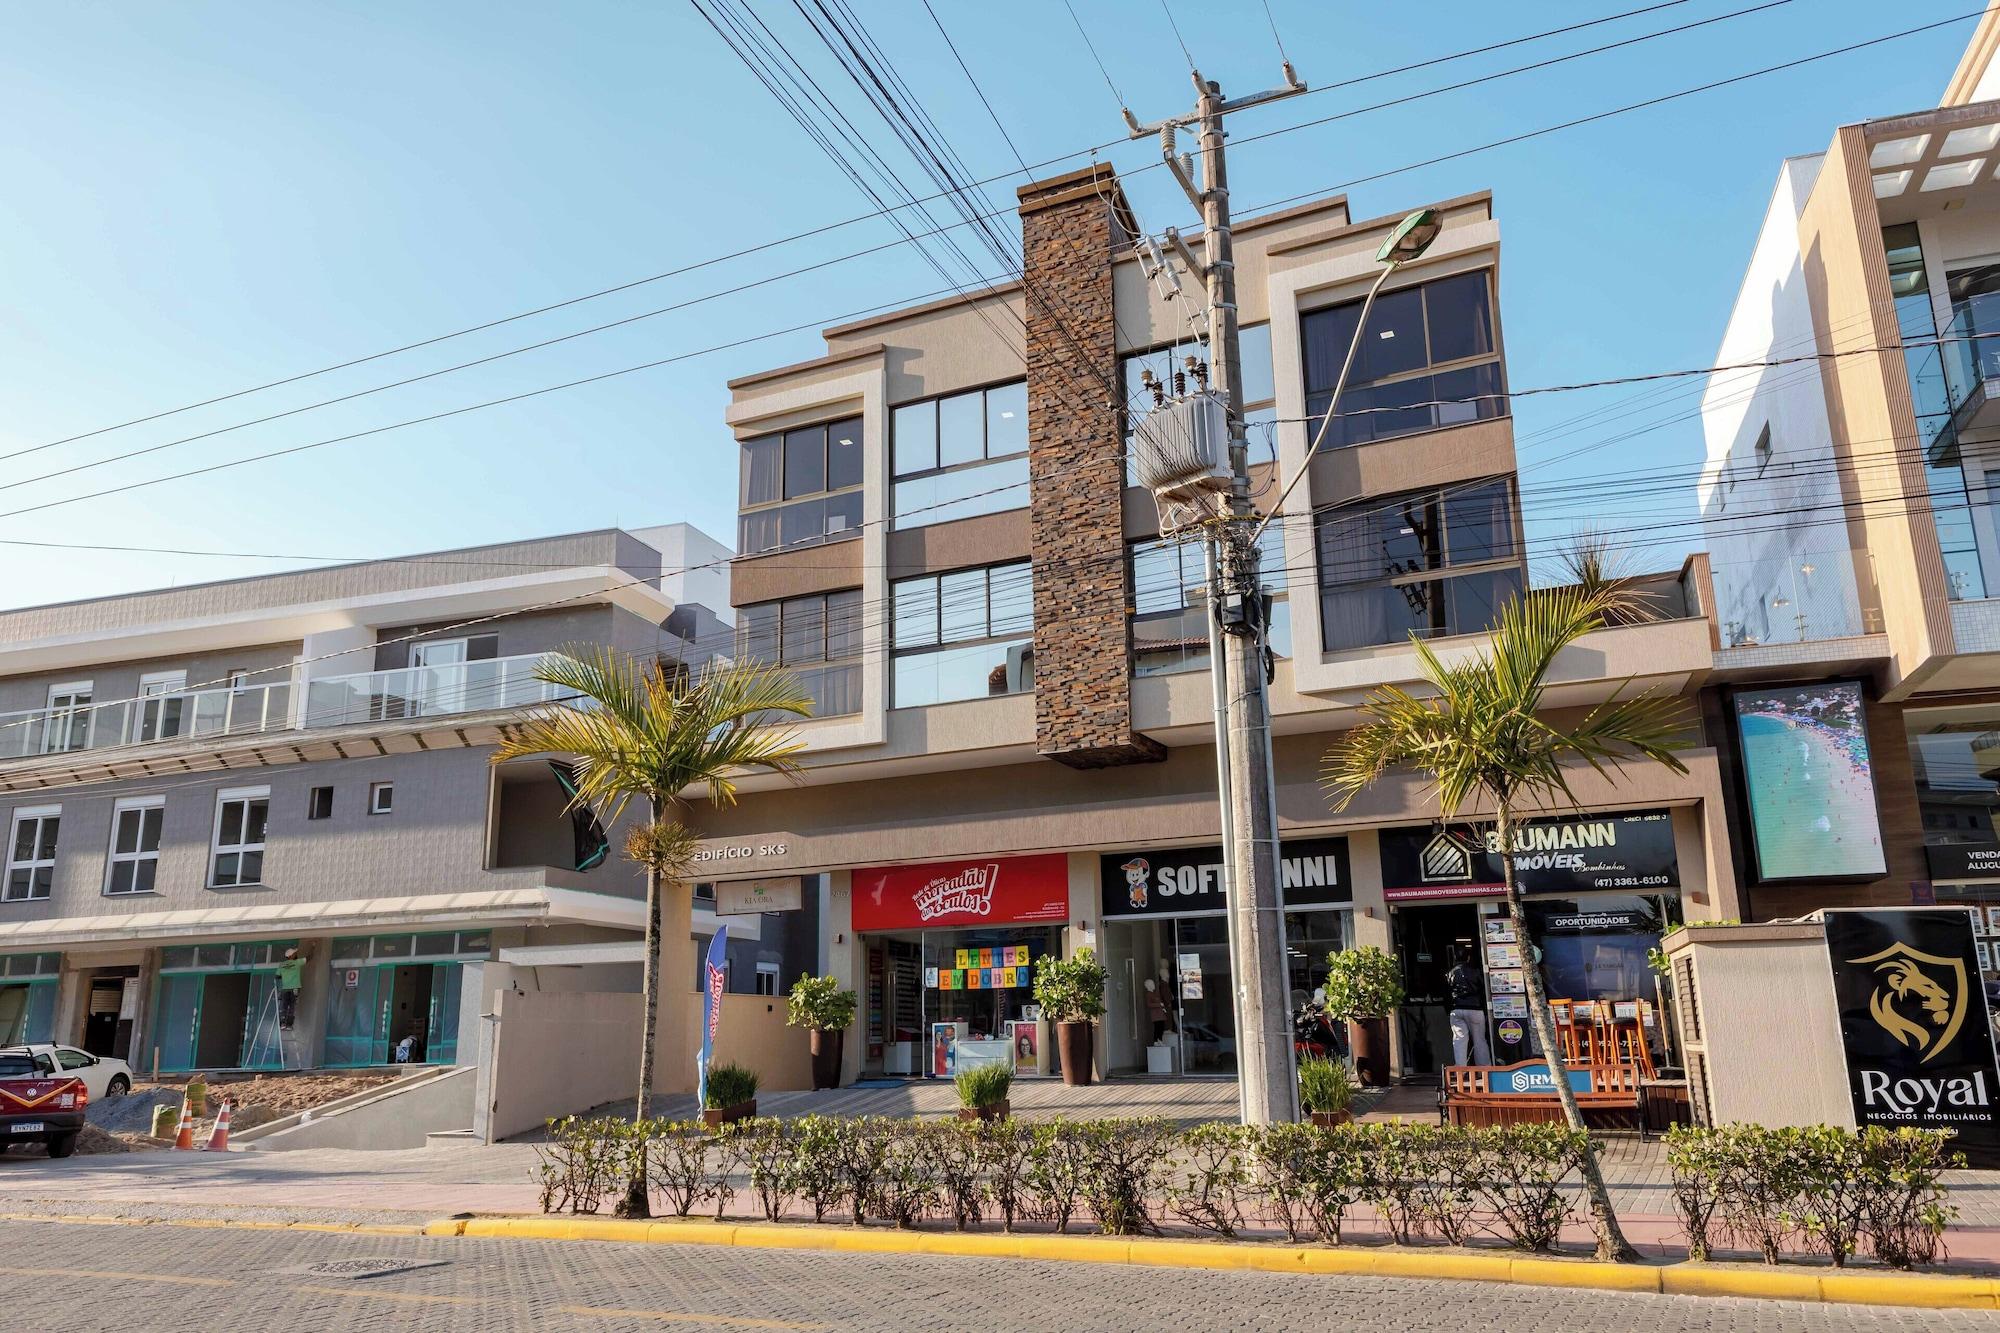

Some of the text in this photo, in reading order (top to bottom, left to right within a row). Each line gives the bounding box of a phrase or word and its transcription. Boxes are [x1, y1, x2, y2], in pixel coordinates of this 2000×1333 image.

[694, 844, 786, 861] EDIFÍCIO SKS
[1572, 862, 1626, 873] Bombinhas
[1594, 875, 1668, 887] (47) 3361-6100
[1555, 916, 1630, 926] OPORTUNIDADES
[957, 951, 1026, 966] LENTES
[941, 974, 963, 986] EM
[969, 971, 1027, 986] DOBRO
[1860, 1070, 1989, 1113] Royal
[1867, 1112, 1992, 1121] NEGÓCIOS IMOBILIÁRIOS
